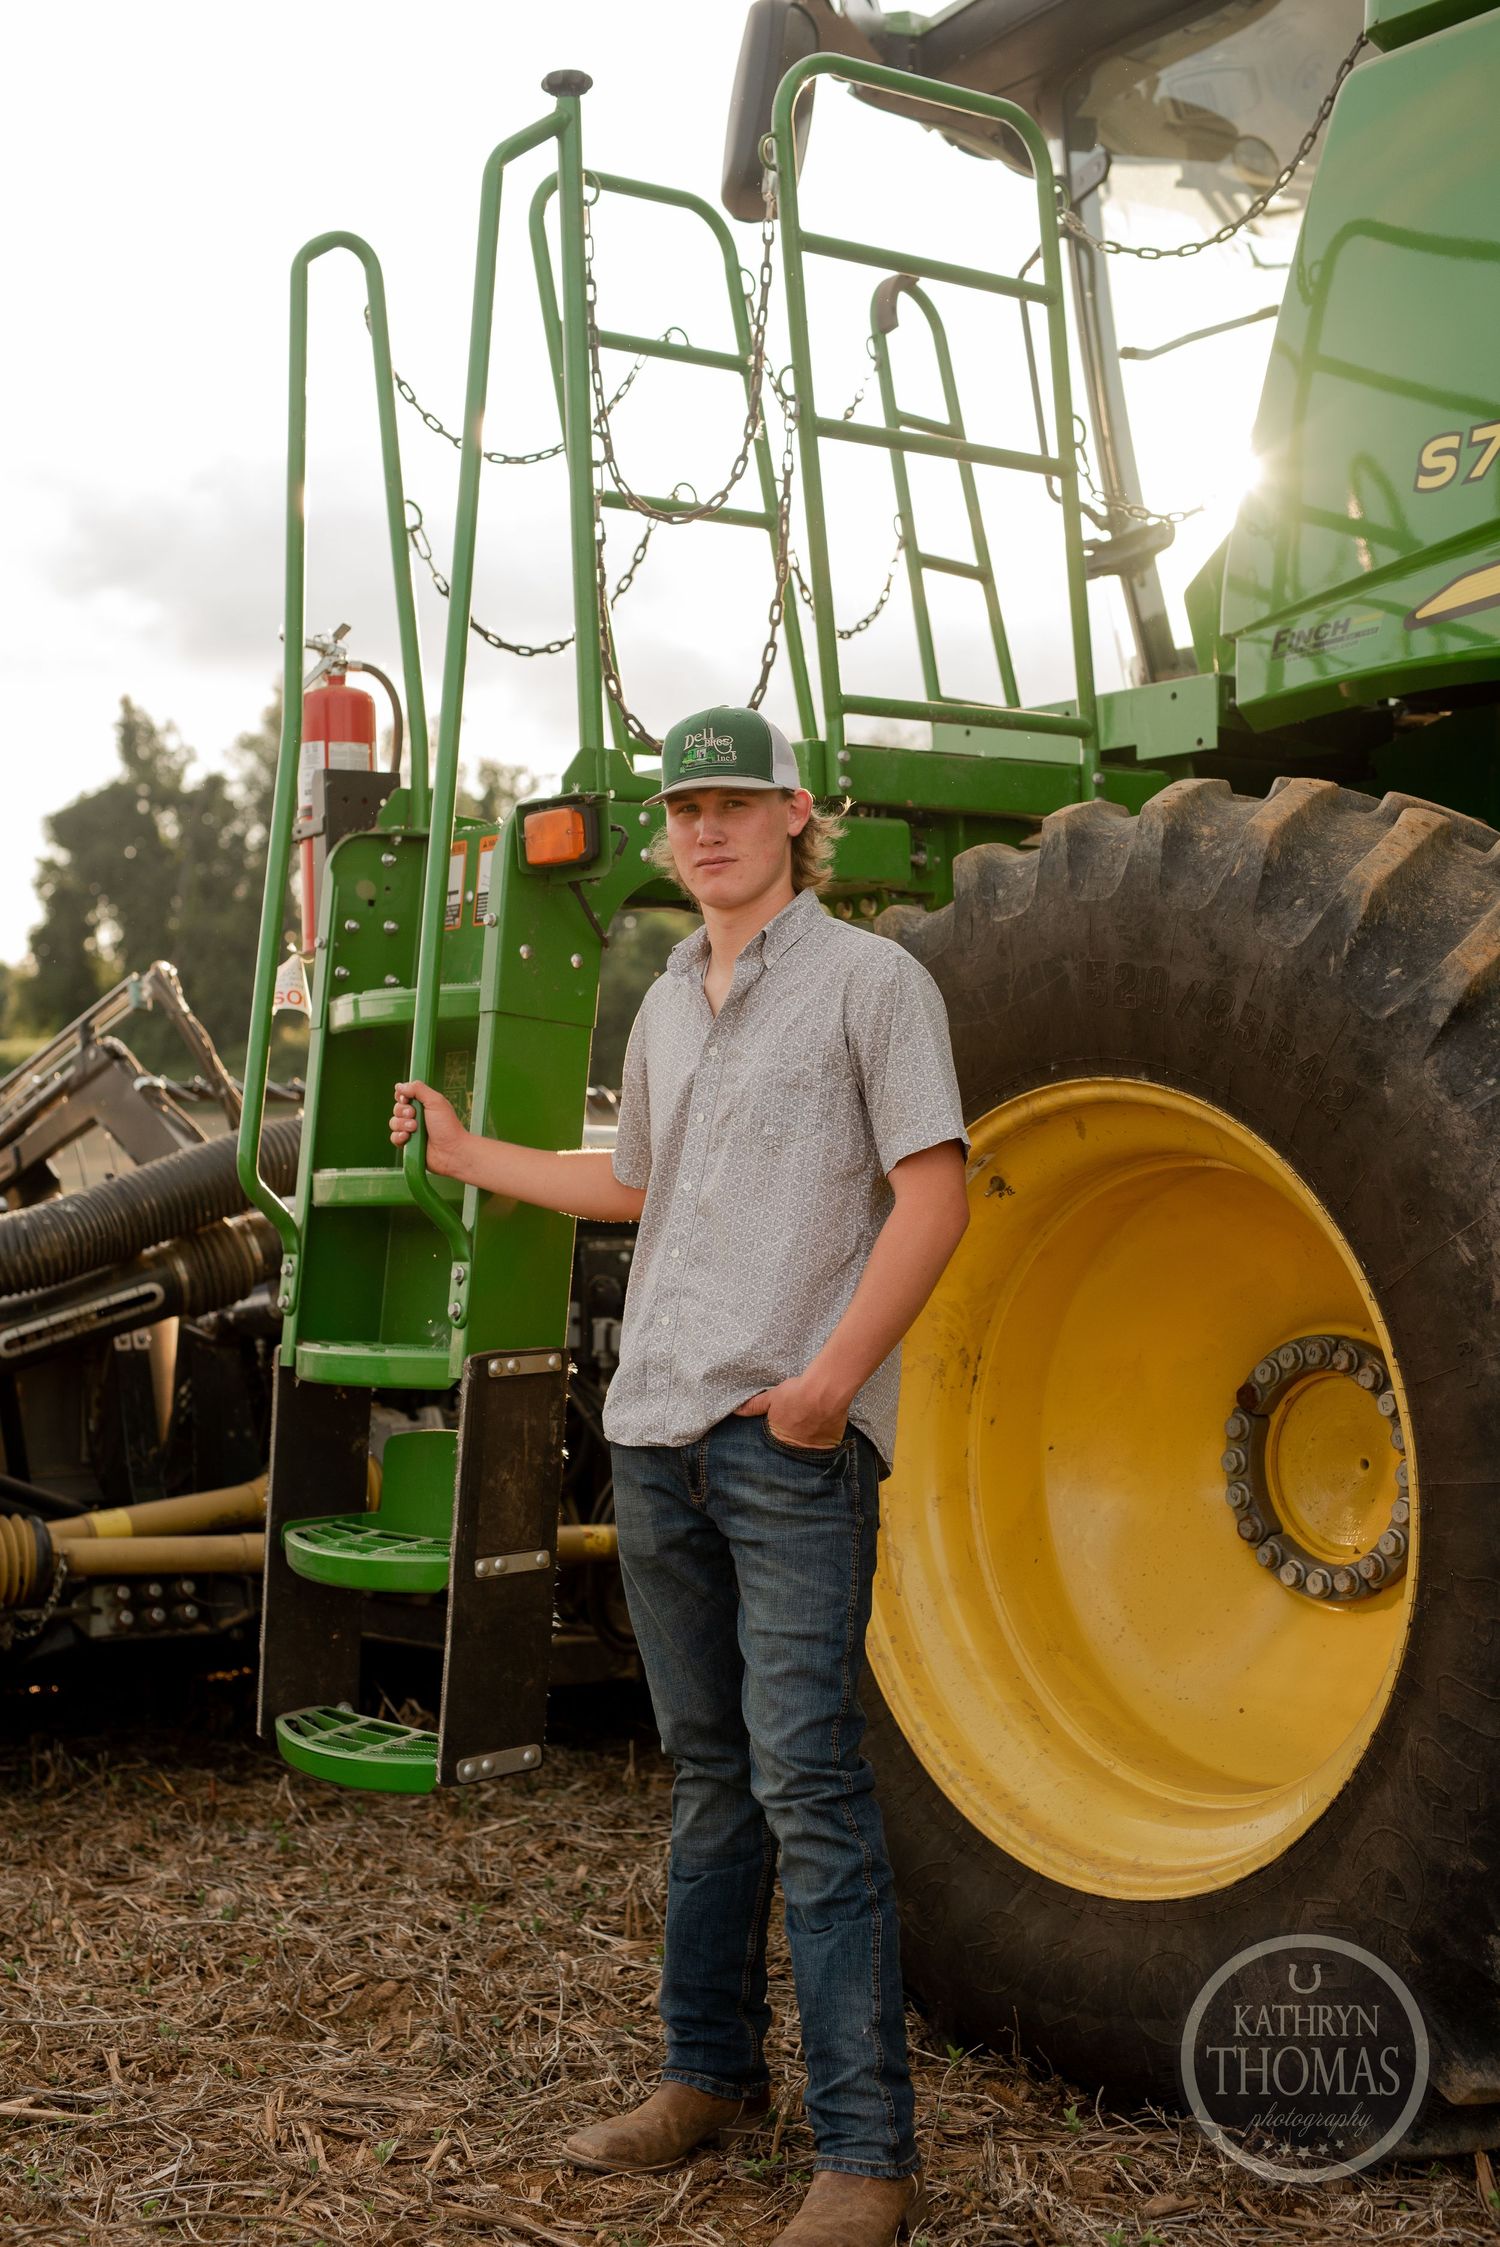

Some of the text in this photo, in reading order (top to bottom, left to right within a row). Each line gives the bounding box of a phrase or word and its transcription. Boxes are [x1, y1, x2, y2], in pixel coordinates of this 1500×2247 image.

[1413, 419, 1500, 493] S7
[1271, 617, 1351, 656] FINCH
[683, 727, 714, 751] Dell
